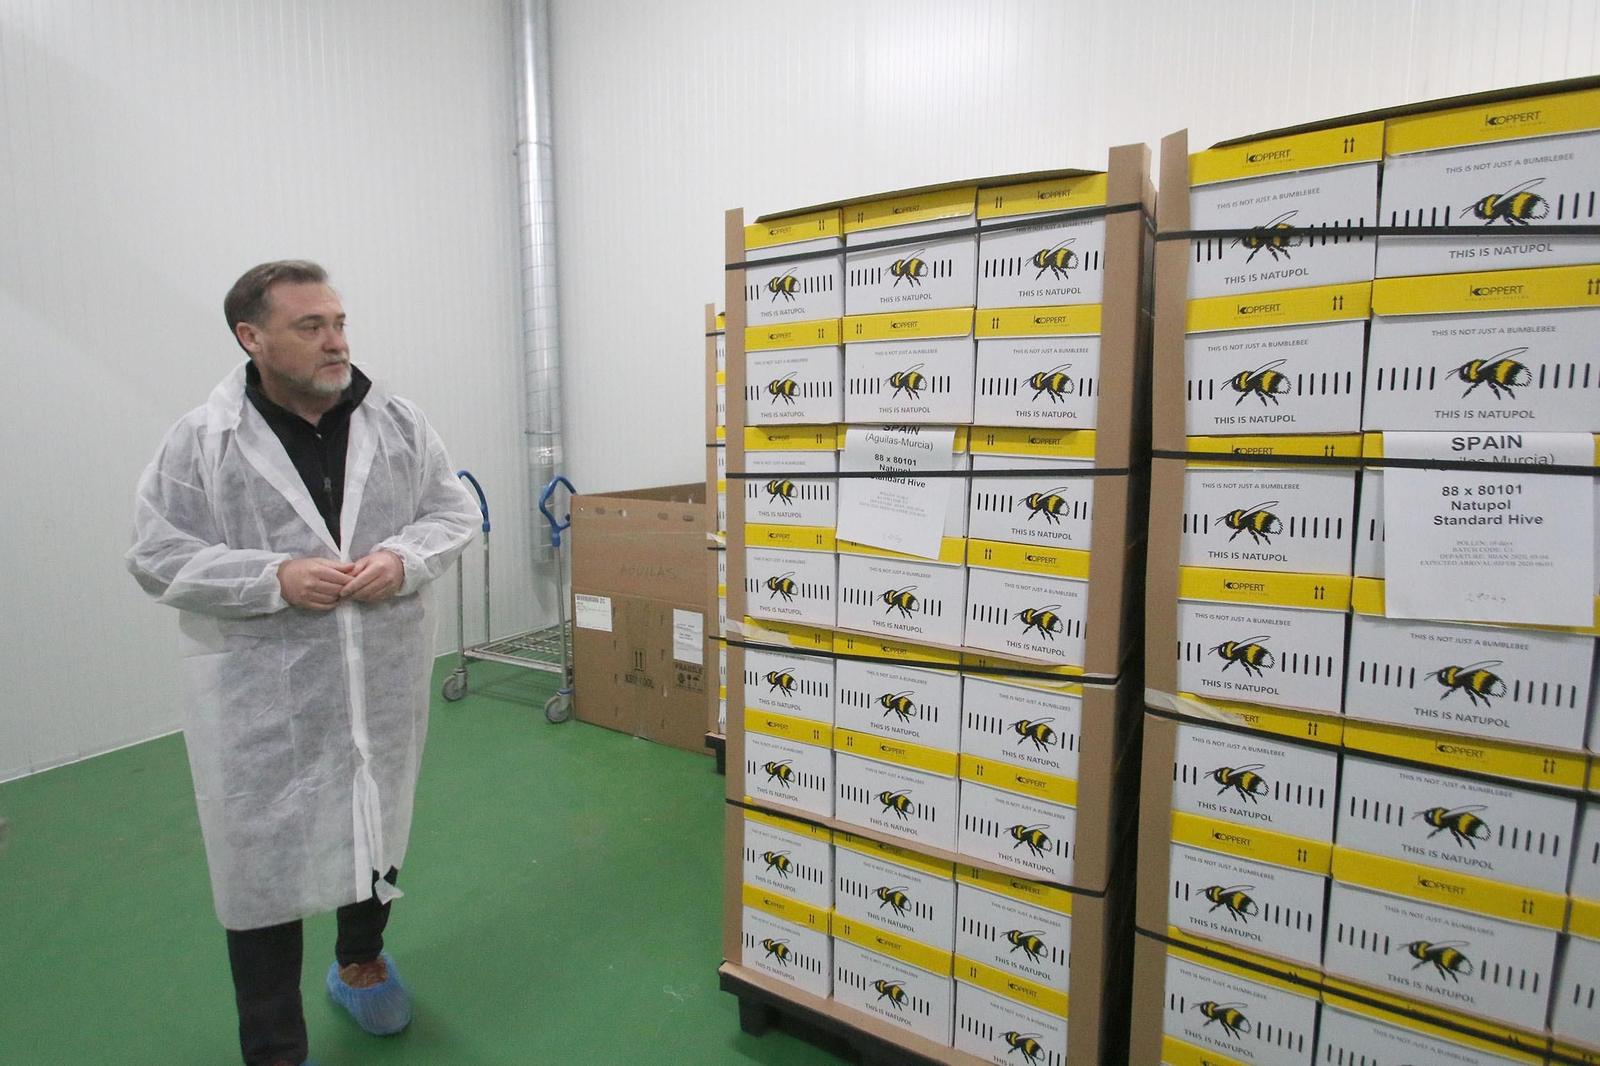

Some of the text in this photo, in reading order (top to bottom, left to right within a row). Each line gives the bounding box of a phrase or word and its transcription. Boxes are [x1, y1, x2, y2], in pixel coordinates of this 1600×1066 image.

[1473, 162, 1491, 170] NOT
[1492, 160, 1512, 168] JUST
[1523, 153, 1573, 164] BUMBLEBEE
[1239, 198, 1253, 206] NOT
[1255, 195, 1270, 203] JUST
[1278, 187, 1320, 199] BUMBLEBEE
[1448, 243, 1553, 258] THIS IS NATUPOL
[1224, 268, 1308, 284] THIS IS NATUPOL
[901, 293, 932, 301] NATUPOL
[1045, 287, 1081, 295] NATUPOL
[1506, 325, 1555, 333] BUMBLEBEE
[1268, 339, 1307, 347] BUMBLEBEE
[1249, 414, 1295, 423] NATUPOL
[1434, 410, 1535, 418] THIS IS NATUPOL
[866, 433, 934, 450] (Aguilas-Murcia)
[1451, 434, 1522, 451] SPAIN
[874, 453, 884, 461] 88
[893, 456, 917, 466] 80101
[908, 477, 926, 488] Hive
[1442, 486, 1459, 496] 88
[1478, 485, 1522, 495] 80101
[1451, 500, 1511, 512] Natupol
[1434, 514, 1543, 525] Standard Hive
[1037, 530, 1072, 540] NATUPOL
[1207, 550, 1228, 558] THIS
[1242, 552, 1287, 562] NATUPOL
[893, 623, 922, 633] NATUPOL
[1252, 618, 1290, 626] BUMBLEBEE
[1006, 640, 1021, 648] THIS
[1031, 645, 1065, 656] NATUPOL
[1201, 678, 1221, 687] THIS
[1234, 683, 1279, 695] NATUPOL
[1413, 707, 1510, 728] THIS IS NATUPOL
[1001, 749, 1016, 758] THIS
[1026, 755, 1060, 768] NATUPOL
[1197, 800, 1216, 810] THIS
[1229, 807, 1272, 822] NATUPOL
[869, 817, 882, 825] THIS
[890, 823, 917, 835] NATUPOL
[998, 852, 1013, 861] THIS
[1022, 860, 1054, 874] NATUPOL
[1401, 843, 1493, 870] THIS IS NATUPOL
[1189, 916, 1208, 926] THIS
[1220, 925, 1261, 941] NATUPOL
[994, 955, 1009, 965] THIS
[1018, 964, 1051, 980] NATUPOL
[1387, 973, 1475, 1003] THIS IS NATUPOL
[1184, 1028, 1202, 1039] THIS
[1214, 1039, 1253, 1058] NATUPOL
